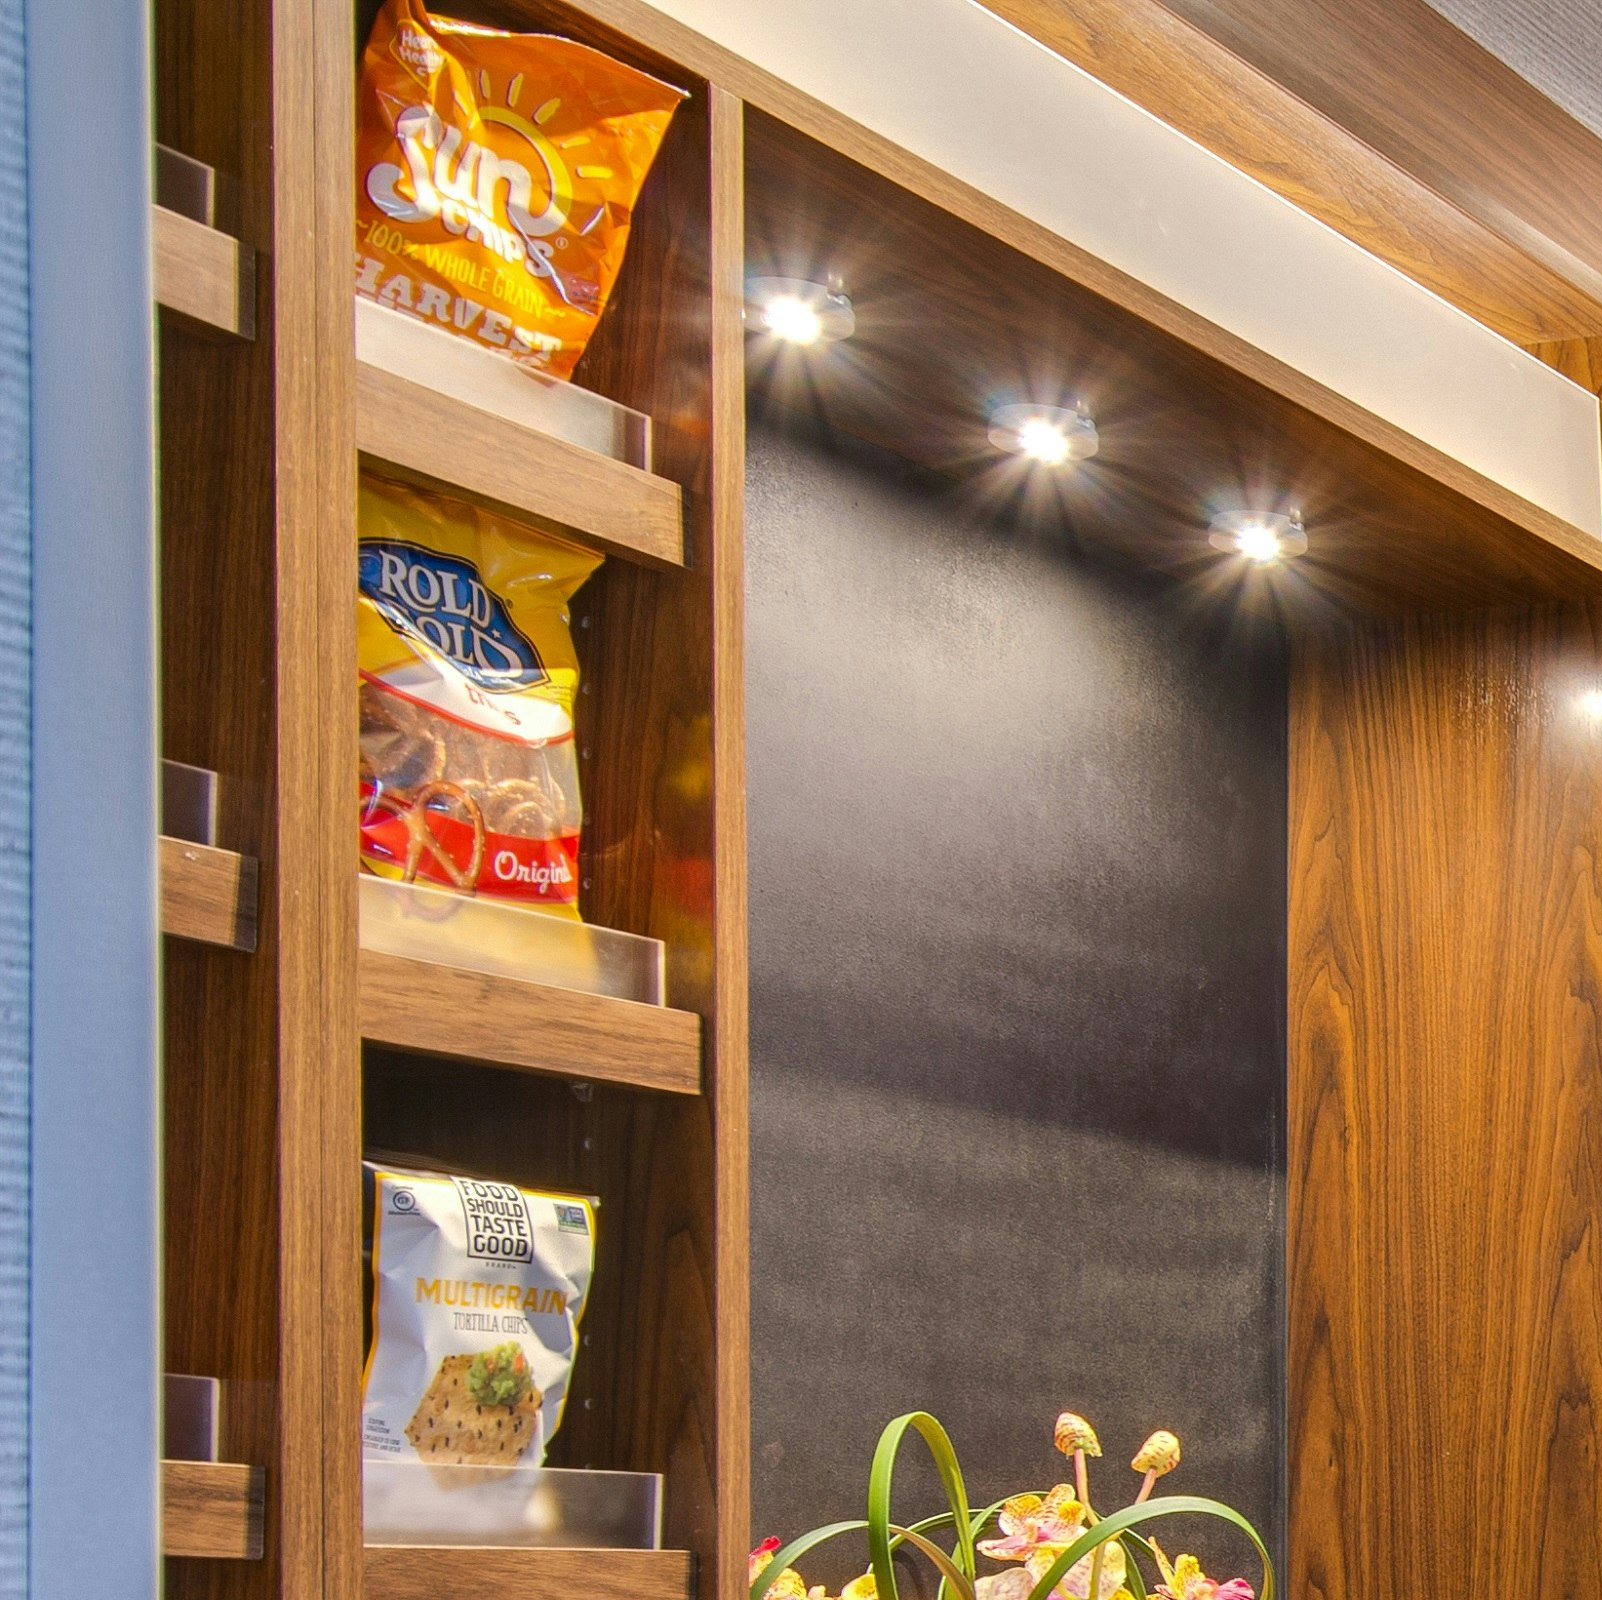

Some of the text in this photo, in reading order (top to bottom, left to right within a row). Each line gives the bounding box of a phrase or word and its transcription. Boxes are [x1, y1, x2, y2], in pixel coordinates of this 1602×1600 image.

[366, 104, 568, 237] Sun
[364, 219, 545, 319] 100% WHOLE GRAIN
[354, 254, 563, 362] HARVEST
[378, 549, 492, 629] ROLD
[386, 600, 524, 679] OLD
[460, 1180, 519, 1202] FOOD
[467, 1198, 524, 1218] SHOULD
[470, 1214, 528, 1237] TASTE
[473, 1234, 529, 1258] GOOD
[415, 1277, 570, 1316] MULTIGRAIN
[453, 1311, 529, 1334] TORTILLA CHIPS
